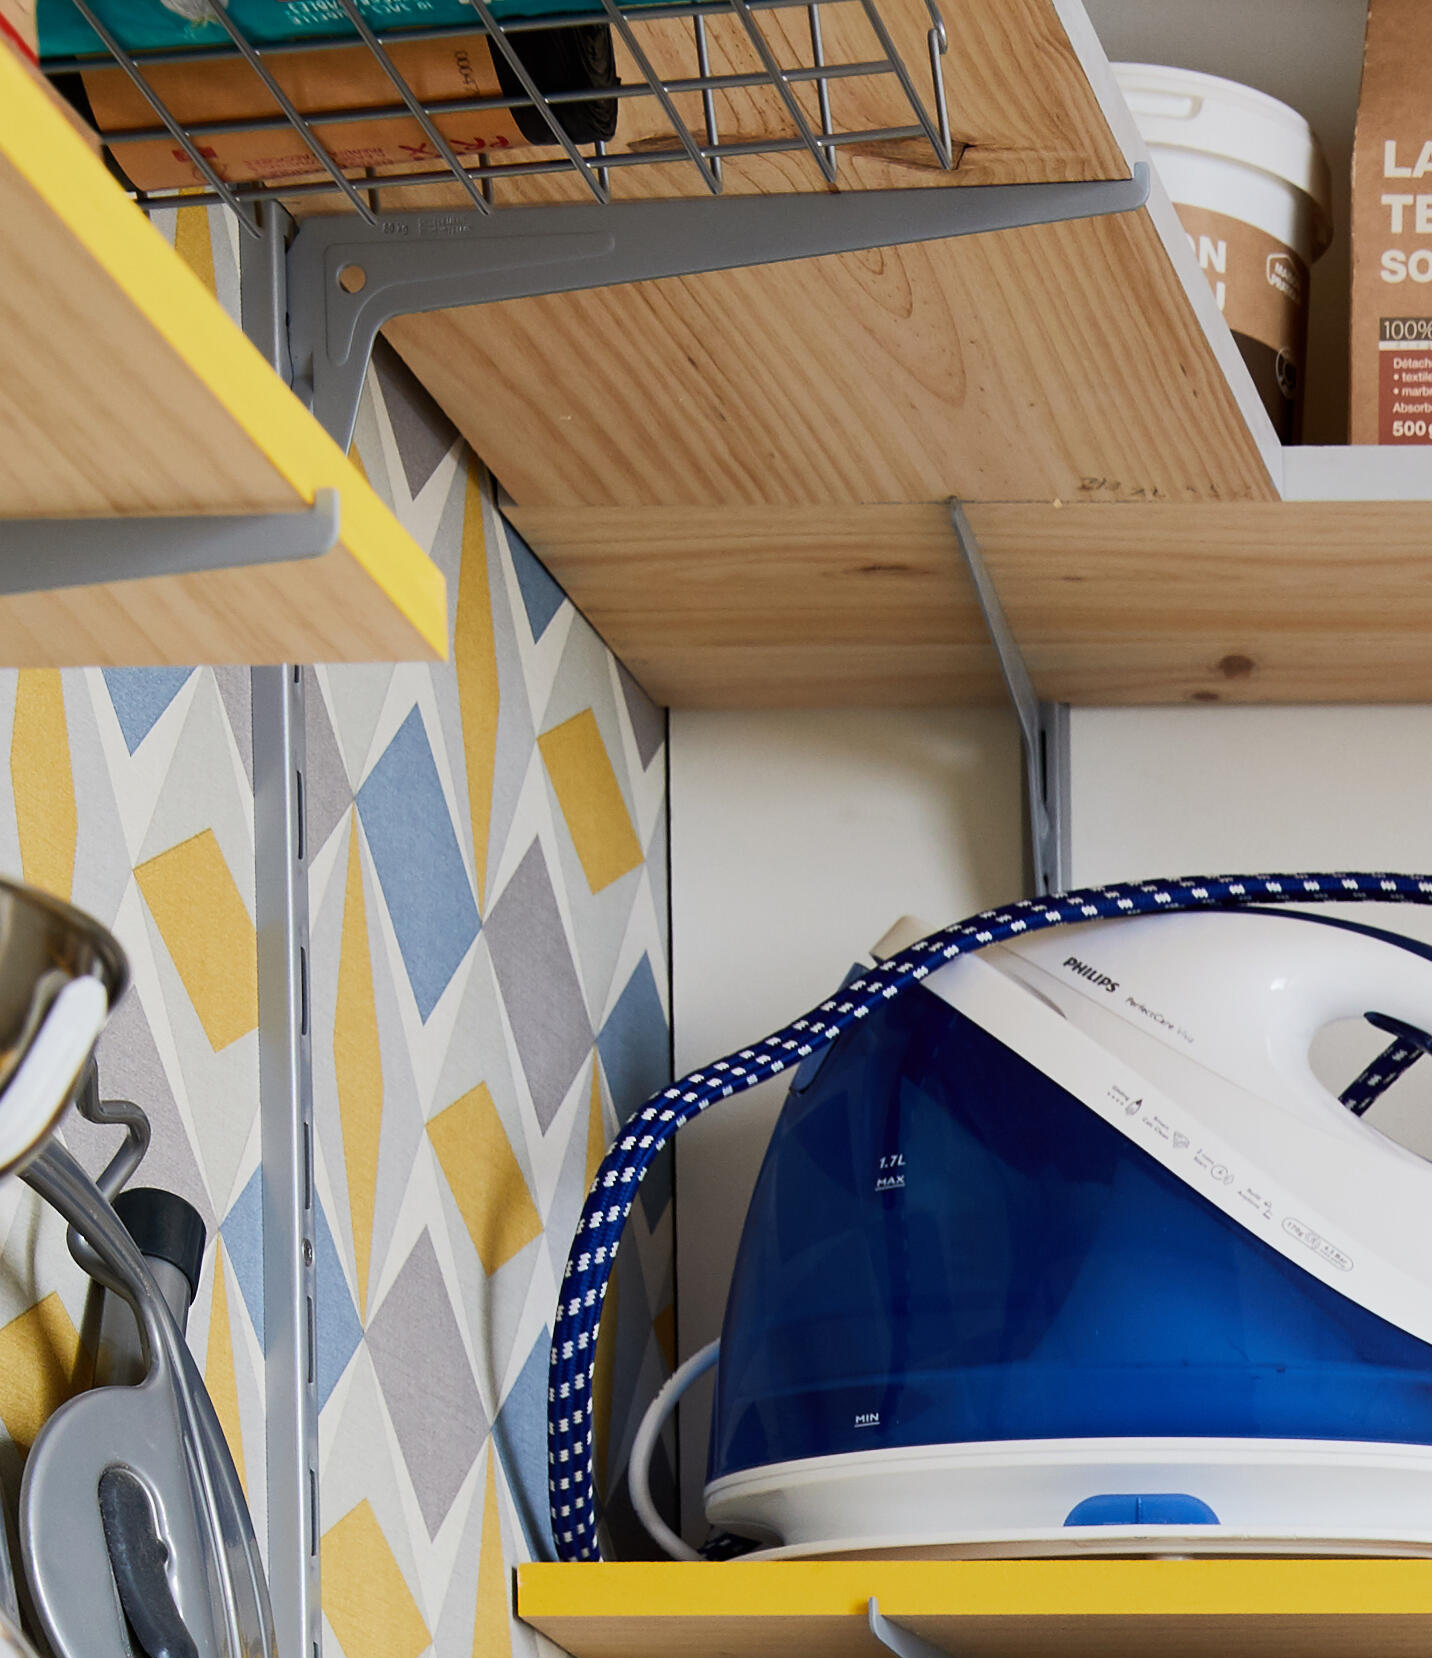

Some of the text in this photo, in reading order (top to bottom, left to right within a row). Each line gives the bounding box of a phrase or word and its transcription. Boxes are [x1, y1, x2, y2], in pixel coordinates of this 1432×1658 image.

[1063, 956, 1120, 993] PHILIPS
[879, 1154, 906, 1169] 1.7L
[876, 1175, 905, 1188] MAX
[855, 1412, 880, 1424] MIN
